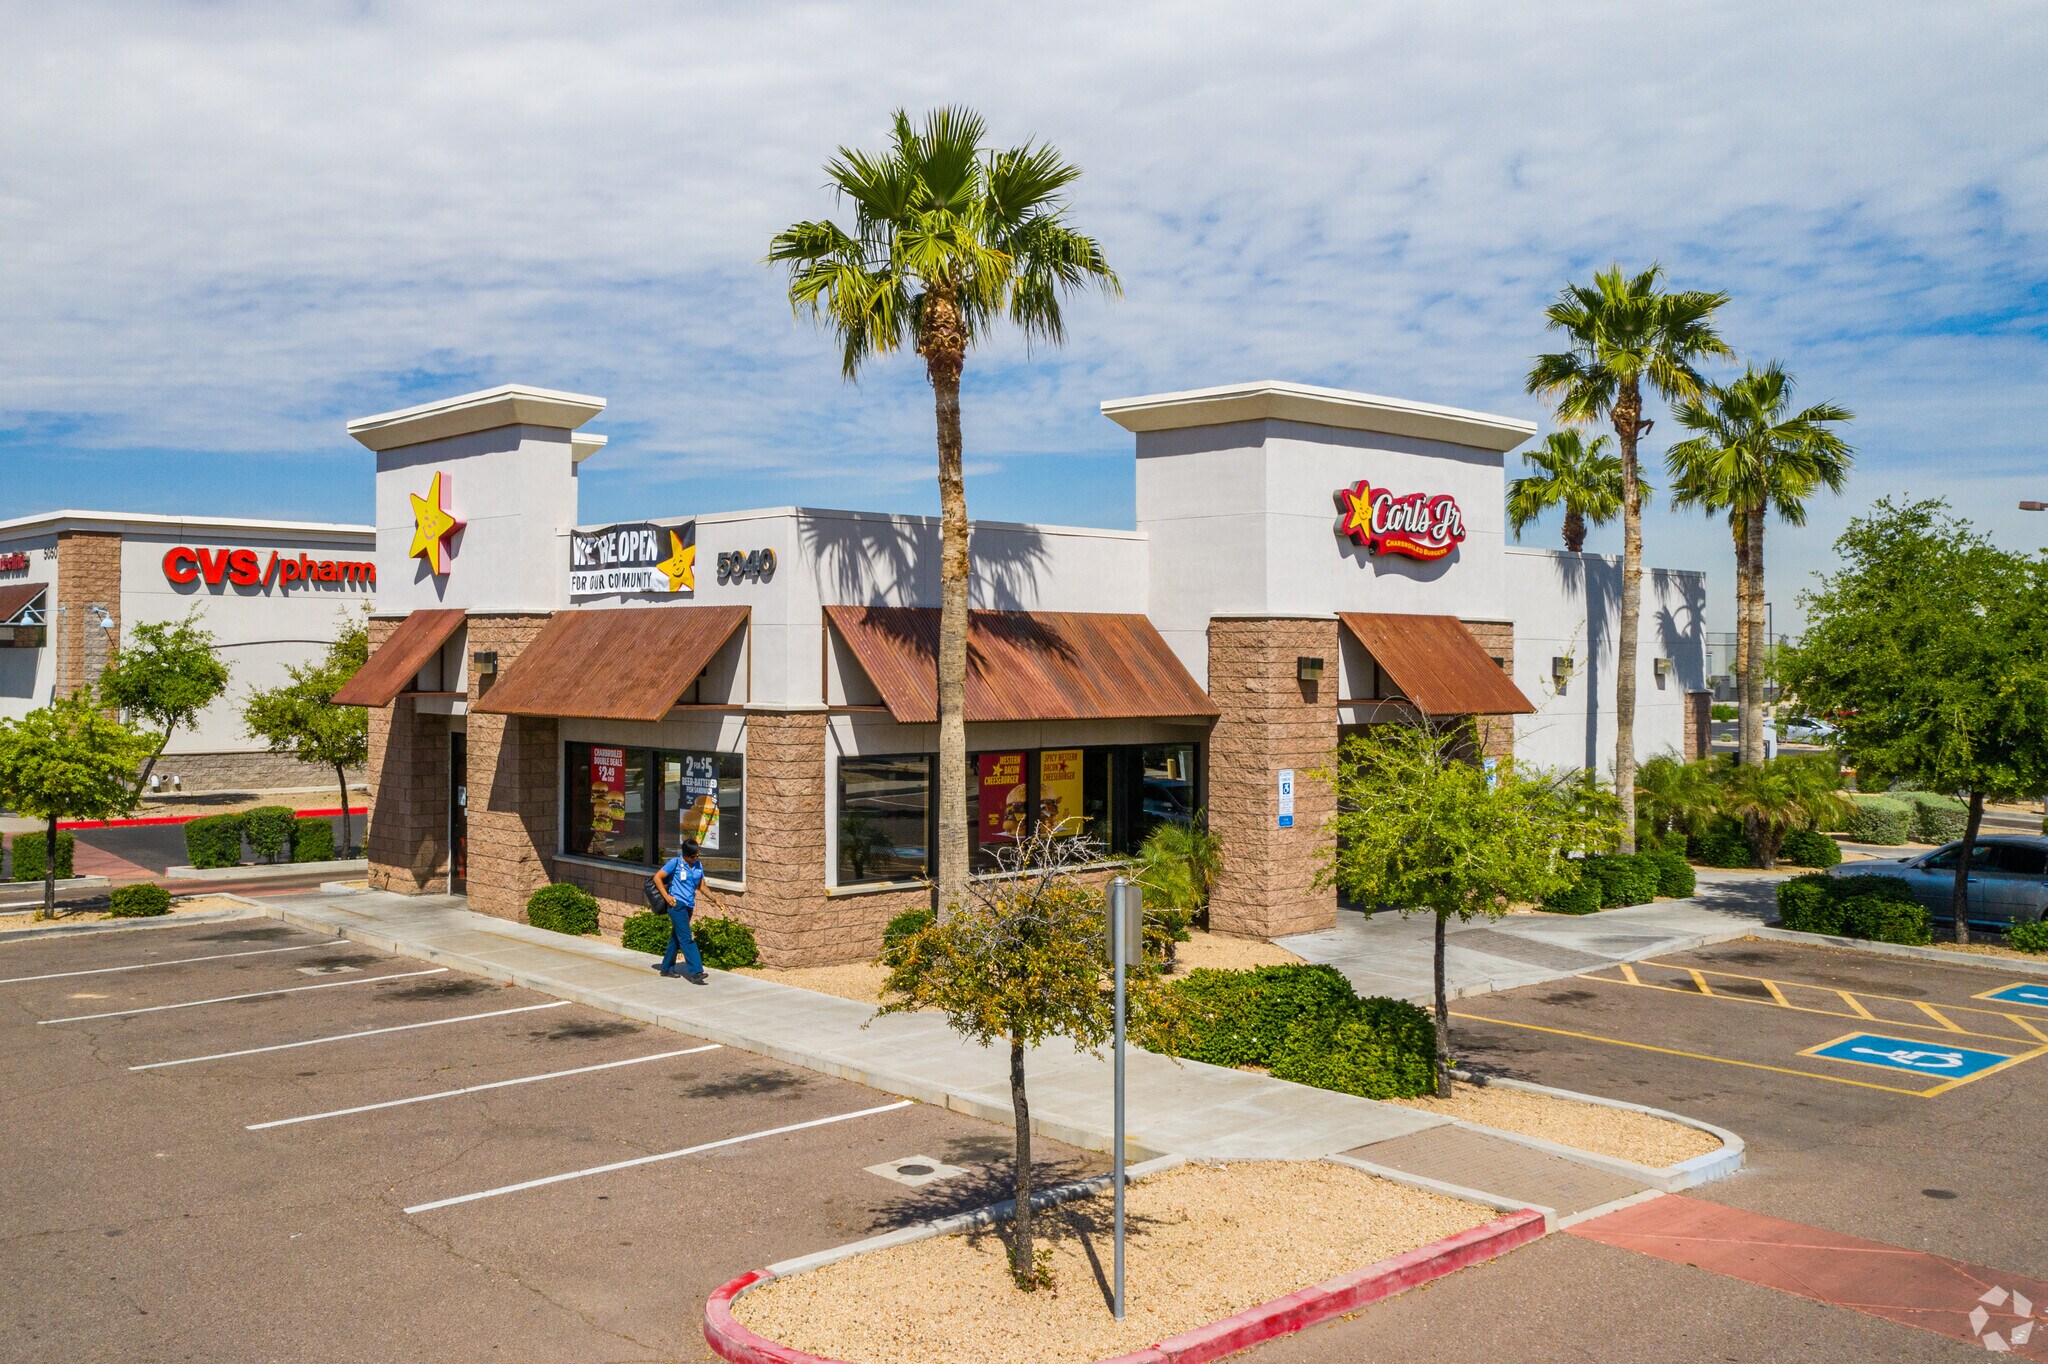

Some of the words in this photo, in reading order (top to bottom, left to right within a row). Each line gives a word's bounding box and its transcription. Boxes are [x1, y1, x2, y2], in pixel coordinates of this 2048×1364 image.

[1371, 493, 1432, 534] Carl's
[1432, 500, 1465, 540] Jr.
[618, 530, 658, 562] OPEN
[717, 548, 777, 577] 5040
[571, 575, 587, 591] FOR
[590, 574, 605, 590] OUR
[686, 756, 694, 776] 2
